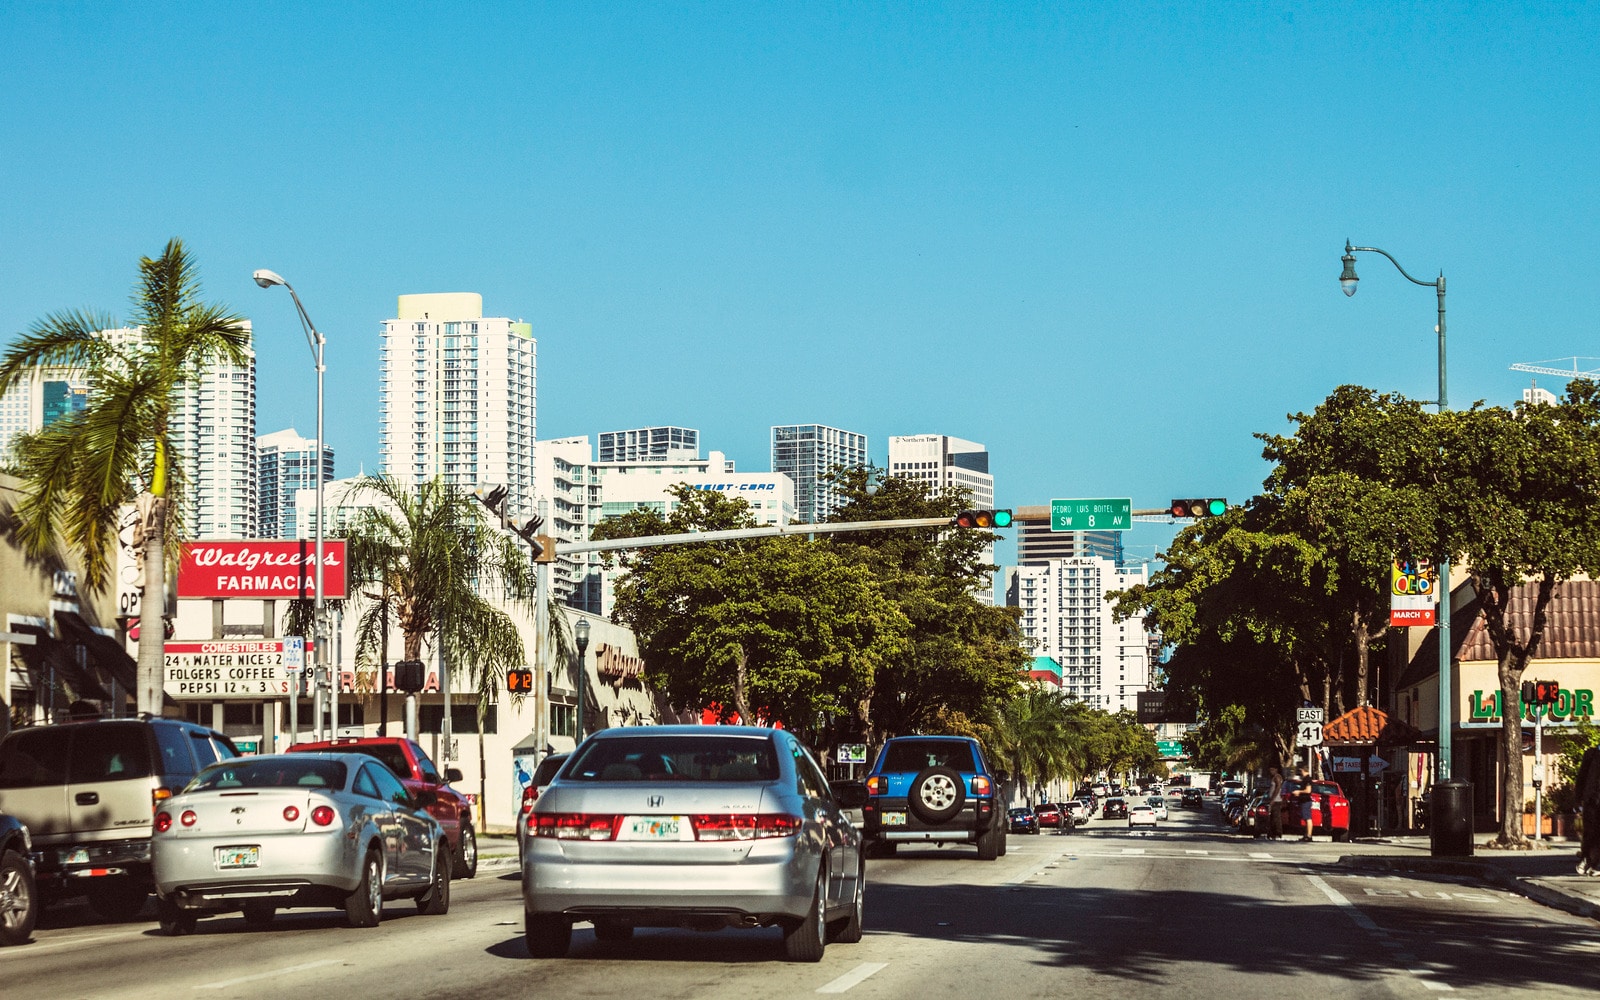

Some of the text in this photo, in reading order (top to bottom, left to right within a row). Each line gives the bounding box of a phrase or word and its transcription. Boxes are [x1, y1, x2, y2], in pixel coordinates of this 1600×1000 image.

[1052, 505, 1072, 514] PEDRO
[1076, 505, 1090, 513] LUIS
[1093, 505, 1114, 513] BOITEL
[1060, 515, 1123, 527] SW 8 AV
[191, 548, 341, 571] Walgreens
[217, 576, 316, 590] FARMACIA
[1393, 611, 1431, 619] MARCH 9
[201, 643, 277, 653] COMESTIBLES
[165, 655, 180, 666] 24
[193, 655, 233, 666] WATER
[238, 654, 264, 665] NICE
[170, 669, 221, 680] FOLGERS
[229, 668, 275, 679] COFFEE
[180, 682, 217, 693] PEPSI
[224, 682, 236, 693] 12
[522, 674, 531, 689] 12
[1549, 684, 1557, 699] 12
[1473, 689, 1594, 718] LIOR
[1299, 710, 1321, 720] EAST
[1302, 727, 1320, 740] 41
